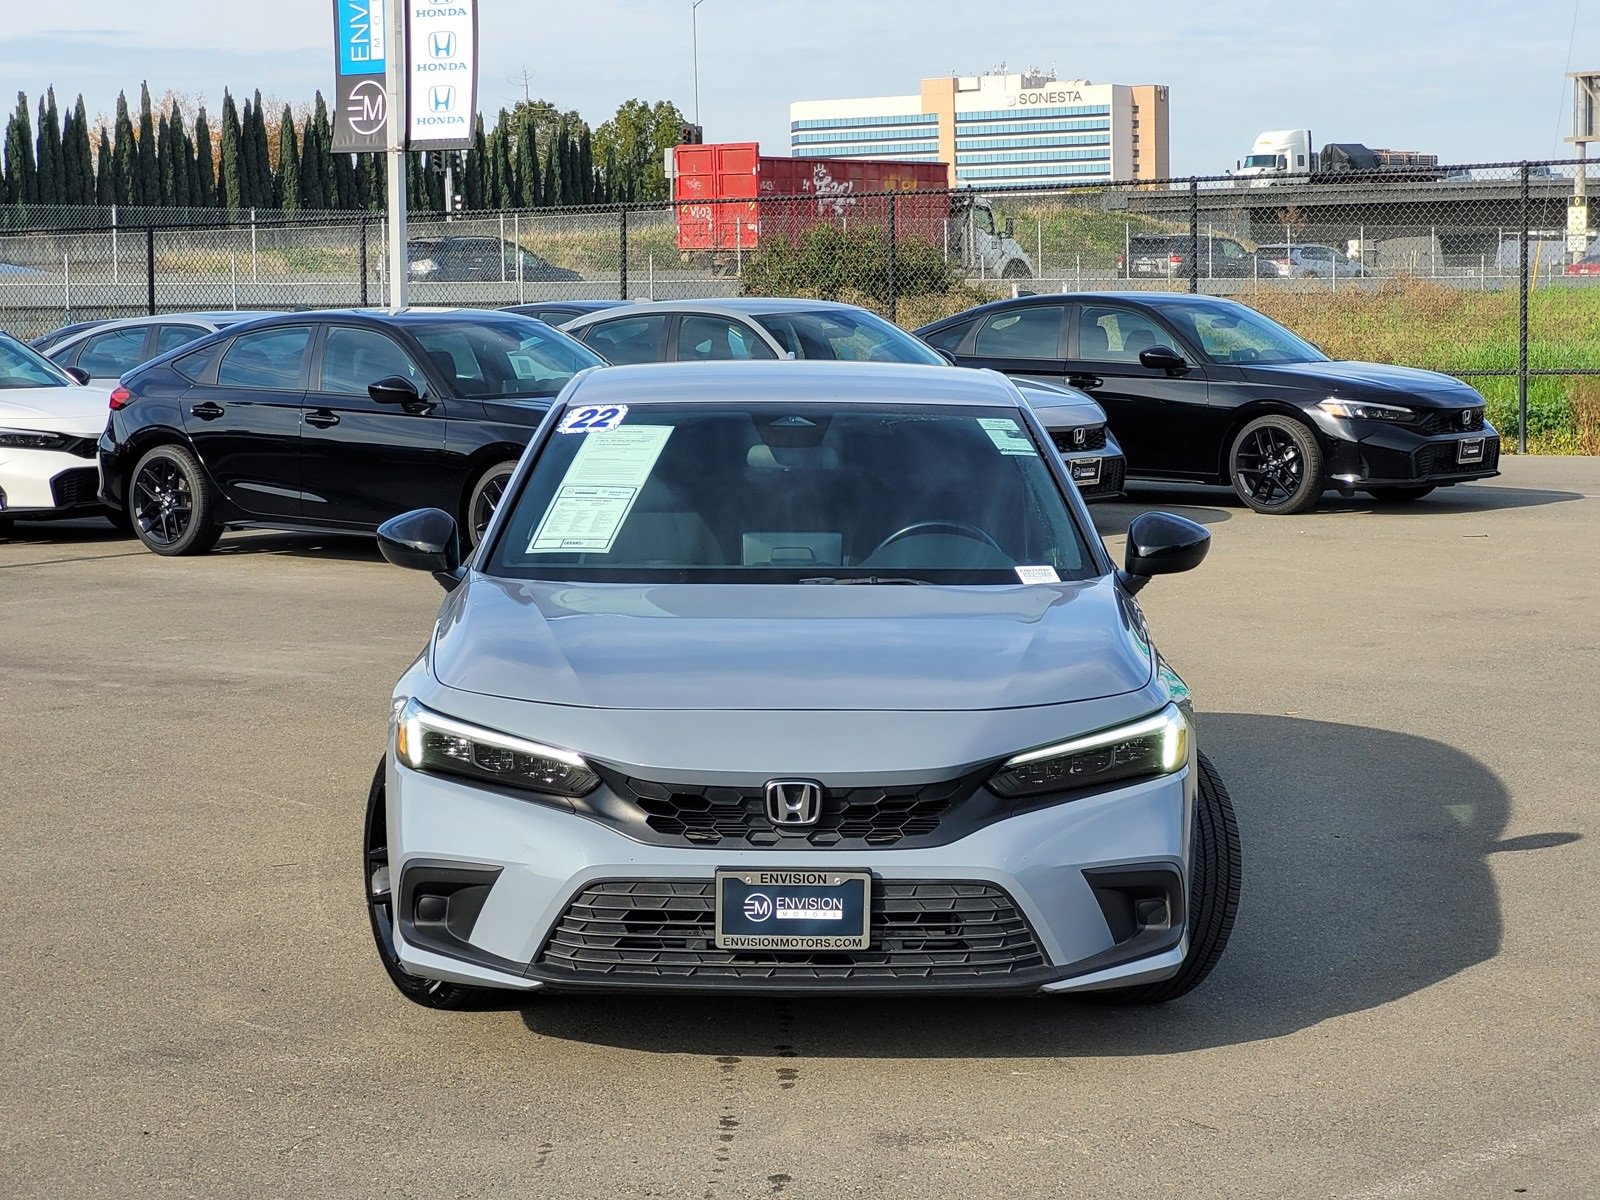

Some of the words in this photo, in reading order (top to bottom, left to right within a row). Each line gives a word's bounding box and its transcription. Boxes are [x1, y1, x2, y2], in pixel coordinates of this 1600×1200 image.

[416, 8, 467, 18] HONDA
[373, 0, 381, 48] MO
[349, 0, 370, 62] ENV
[416, 62, 468, 72] HONDA
[1018, 91, 1083, 105] SONESTA
[416, 116, 466, 126] HONDA
[567, 408, 620, 429] 22
[760, 873, 827, 884] ENVISION
[776, 897, 843, 910] ENVISION
[723, 937, 862, 948] ENVISIONMOTORS.COM
